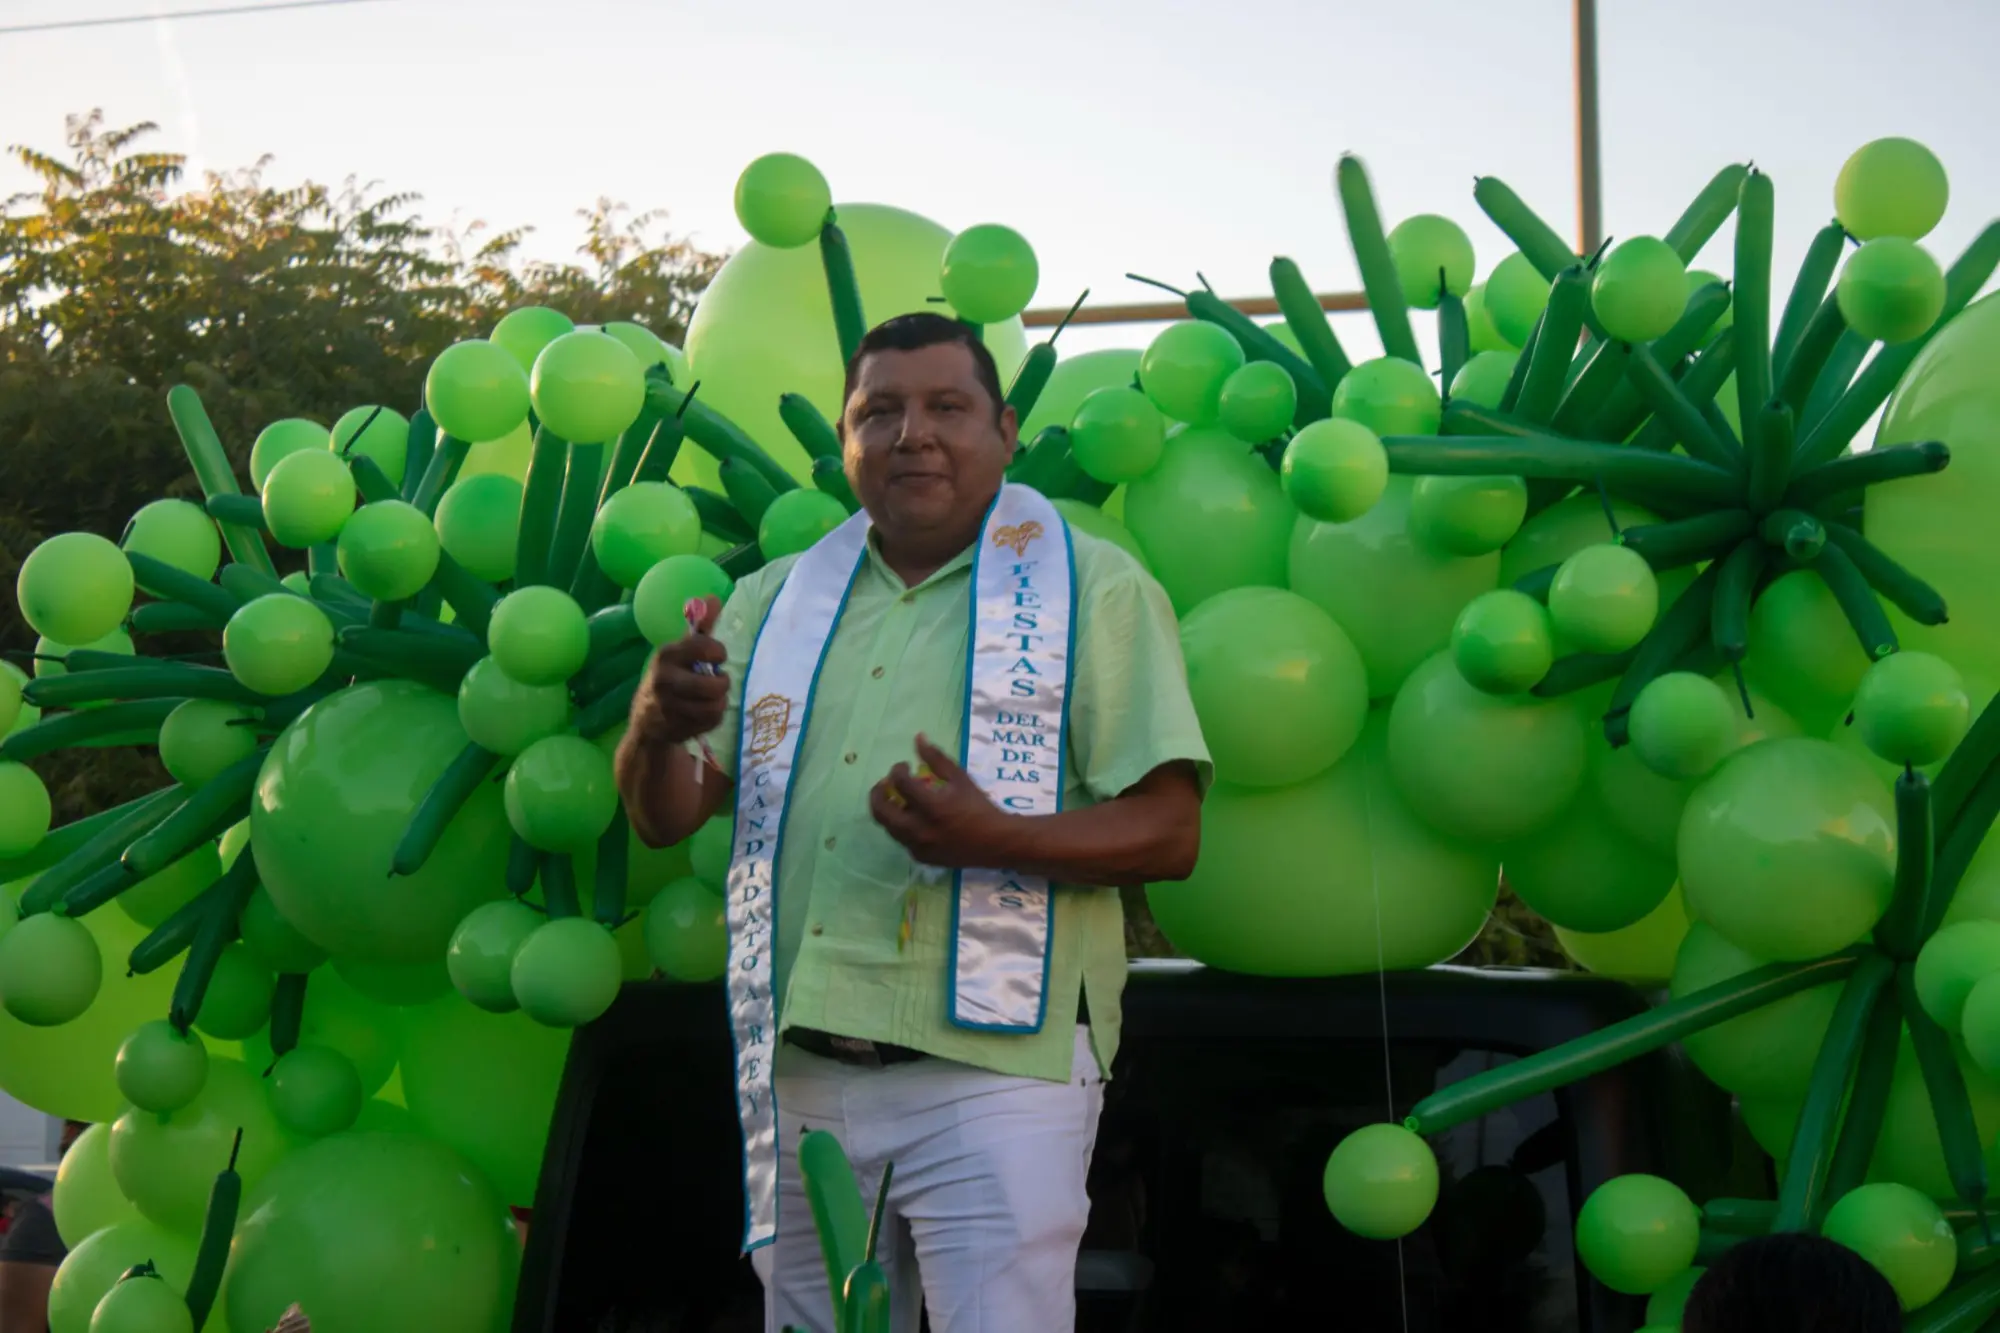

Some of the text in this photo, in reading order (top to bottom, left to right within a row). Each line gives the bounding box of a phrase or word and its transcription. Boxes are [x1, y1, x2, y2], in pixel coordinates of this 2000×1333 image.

[1005, 560, 1043, 698] FIESTAS
[995, 710, 1045, 728] DEL
[992, 730, 1045, 747] MAR
[1001, 747, 1036, 765] DE
[996, 767, 1040, 784] LAS
[741, 770, 770, 1116] CANDIDATO A REY
